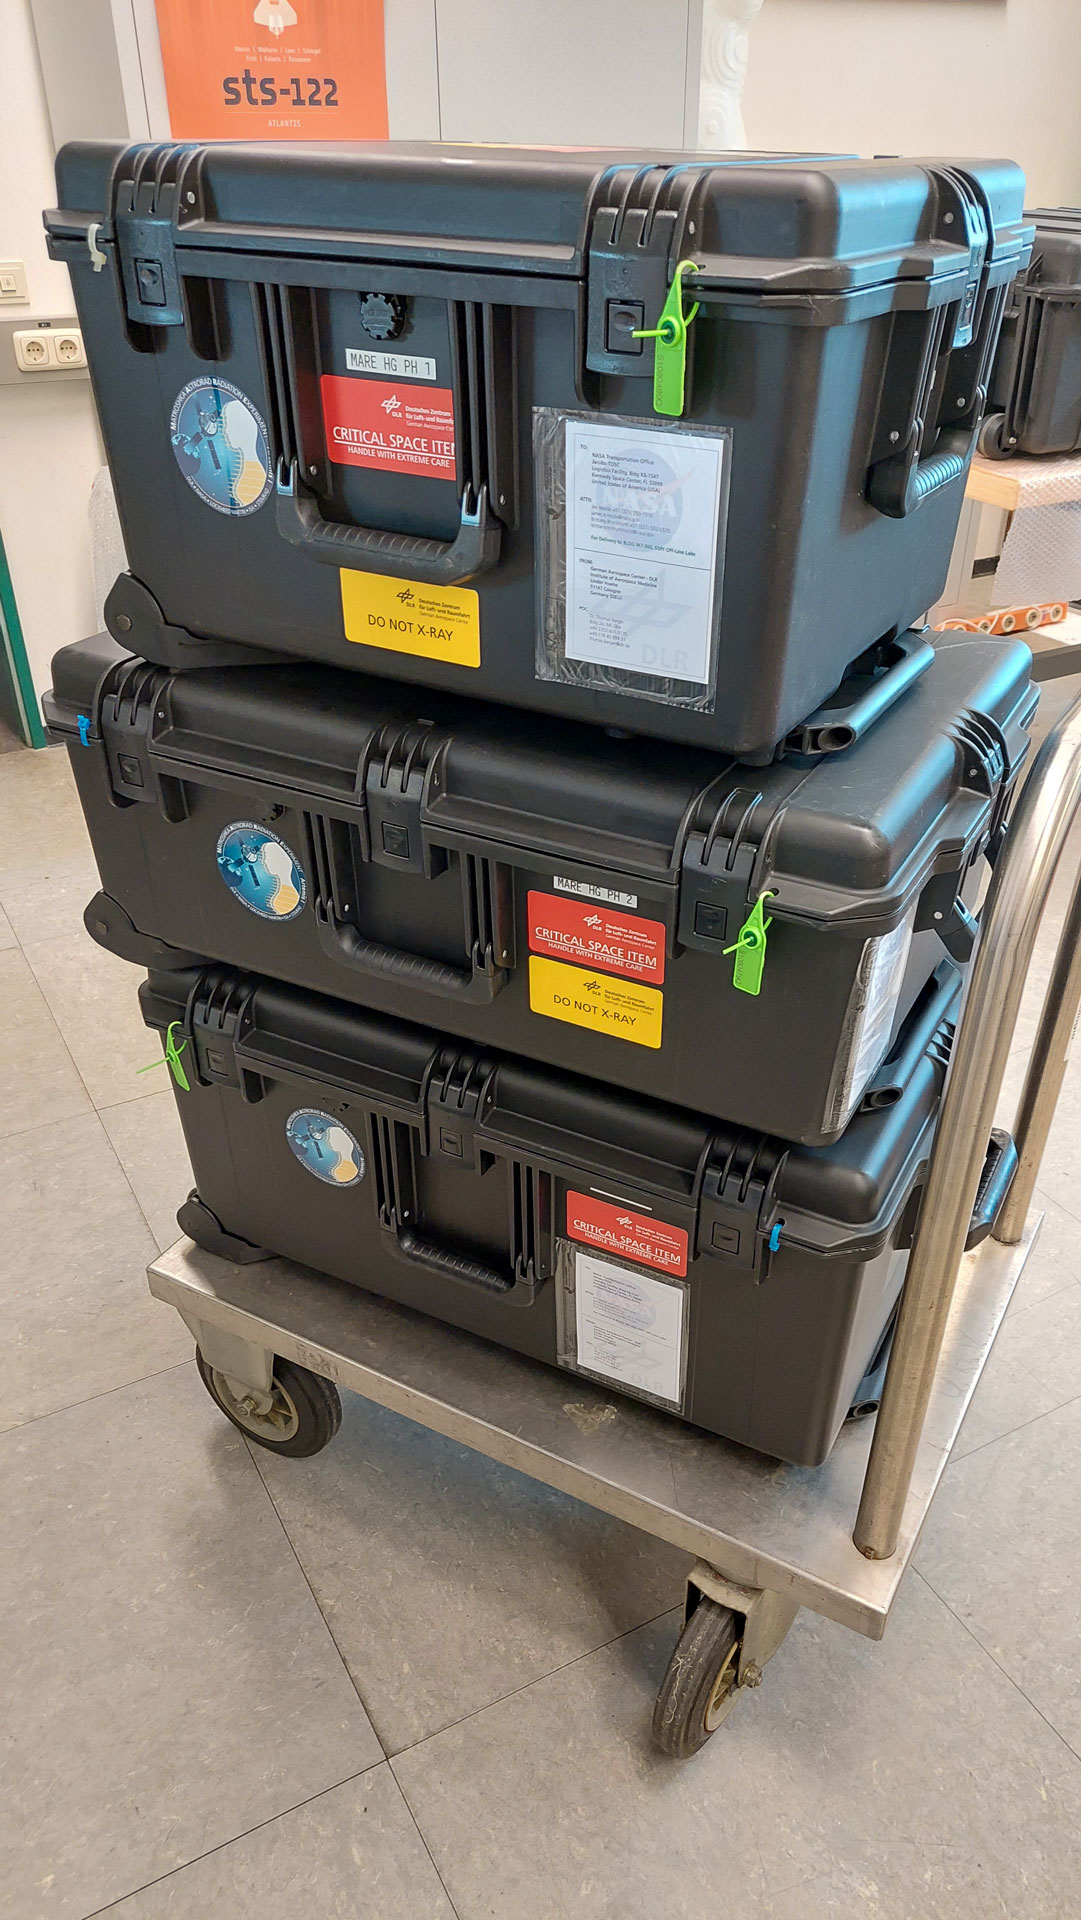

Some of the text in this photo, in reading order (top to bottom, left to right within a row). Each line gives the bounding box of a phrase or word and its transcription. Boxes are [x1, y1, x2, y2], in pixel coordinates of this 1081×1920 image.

[222, 69, 338, 106] sts-122
[350, 353, 430, 376] MARE HG PH 1
[185, 378, 212, 394] ASTRORAD
[212, 378, 244, 400] RADIATION
[242, 396, 268, 438] EXPERIMENT
[405, 406, 451, 416] Deutsches Zentrum
[424, 422, 446, 430] Aerospace
[333, 426, 387, 446] CRITICAL
[389, 434, 428, 452] SPACE
[348, 446, 450, 468] HANDLE WITH EXTREME CARE
[606, 454, 640, 464] Transportation
[592, 466, 610, 474] Logistics
[592, 472, 612, 480] Kennedy
[628, 484, 646, 492] America
[598, 536, 616, 545] Delivery
[666, 546, 684, 556] Off-Line
[608, 568, 630, 578] Aerospace
[614, 576, 636, 586] Aerospace
[638, 580, 658, 588] Medicine
[590, 590, 609, 599] Germany
[603, 586, 621, 594] Cologne
[419, 598, 460, 610] Deutsches Zentrum
[435, 613, 456, 622] Aerospace
[456, 616, 468, 624] Center
[447, 609, 470, 619] Raumfahrt
[368, 614, 454, 642] DO NOT X-RAY
[642, 644, 688, 671] DLR
[254, 824, 280, 843] RADIATION
[280, 841, 304, 873] EXPERIMENT
[557, 877, 632, 905] MARE HG PH 2
[606, 924, 648, 938] Deutsches Zentrum
[535, 926, 657, 967] CRITICAL SPACE ITEM
[622, 938, 641, 946] Aerospace
[634, 936, 656, 946] Raumfahrt
[548, 942, 644, 972] HANDLE WITH EXTREME CARE
[604, 990, 646, 1004] Deutsches Zentrum
[553, 994, 637, 1026] DO NOT X-RAY
[620, 1004, 639, 1012] Aerospace
[632, 1002, 654, 1012] Raumfahrt
[573, 1219, 618, 1242] CRITICAL
[620, 1235, 652, 1253] SPACE
[655, 1248, 681, 1263] ITEM
[584, 1232, 608, 1246] HANDLE
[609, 1238, 625, 1250] WITH
[625, 1244, 652, 1260] EXTREME
[652, 1256, 670, 1266] CARE
